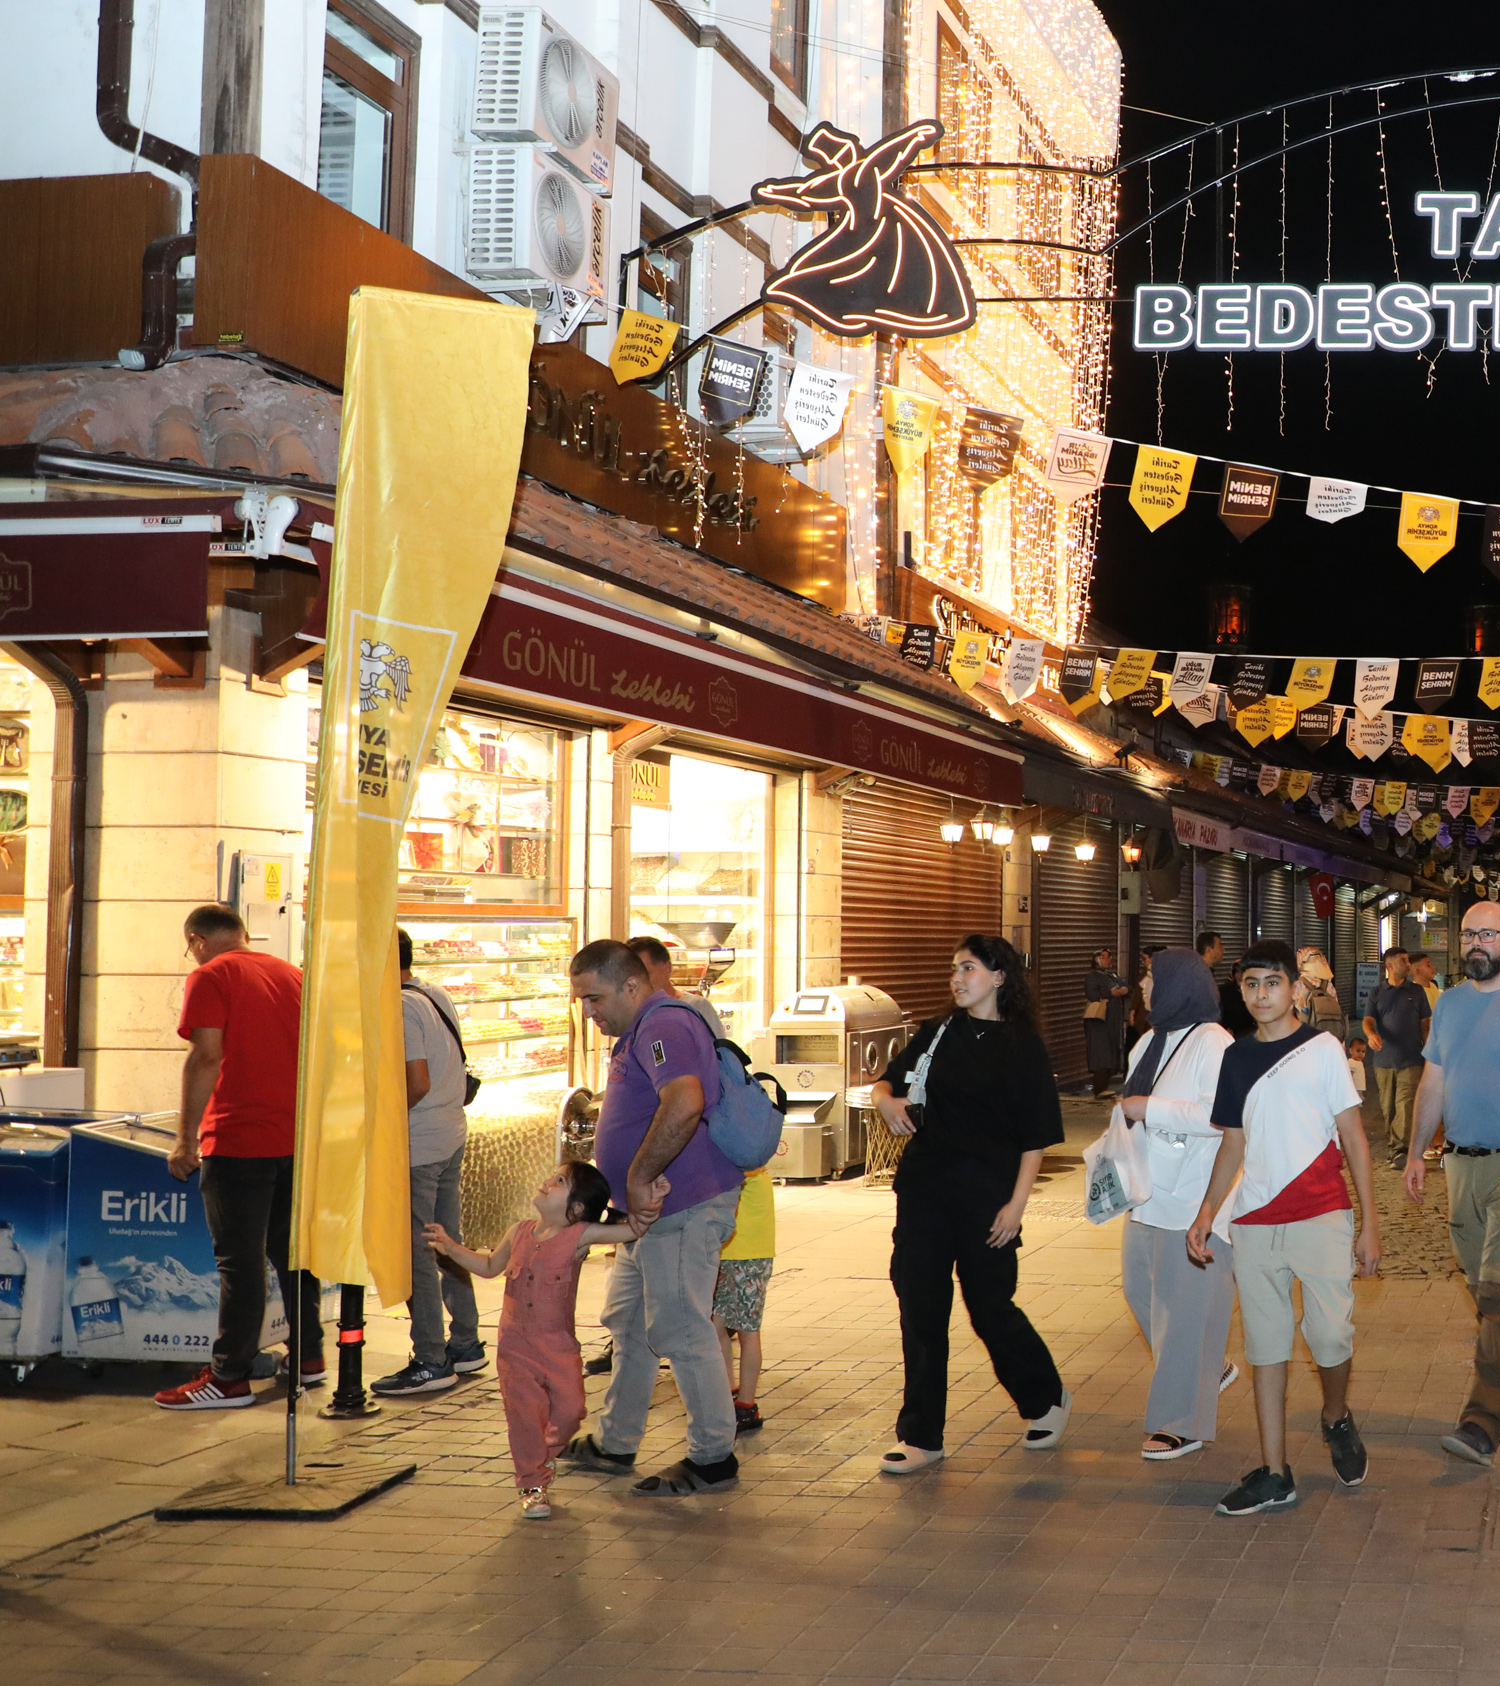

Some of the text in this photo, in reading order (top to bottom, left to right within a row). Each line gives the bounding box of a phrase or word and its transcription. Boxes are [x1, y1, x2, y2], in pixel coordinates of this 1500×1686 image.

[596, 78, 606, 139] arçelik
[592, 201, 605, 279] arçelik
[502, 627, 601, 692] GÖNÜL
[1067, 658, 1093, 669] BENİM
[1065, 667, 1091, 677] ŞEHRİM
[1422, 671, 1454, 680] BENİM
[1421, 680, 1452, 689] ŞEHRİM
[881, 735, 923, 773] GÖNÜL
[1267, 1067, 1278, 1079] KEEP
[1279, 1054, 1296, 1068] GOING
[101, 1190, 187, 1224] Erikli
[80, 1302, 110, 1318] Erikli
[143, 1334, 209, 1346] 444 0 222
